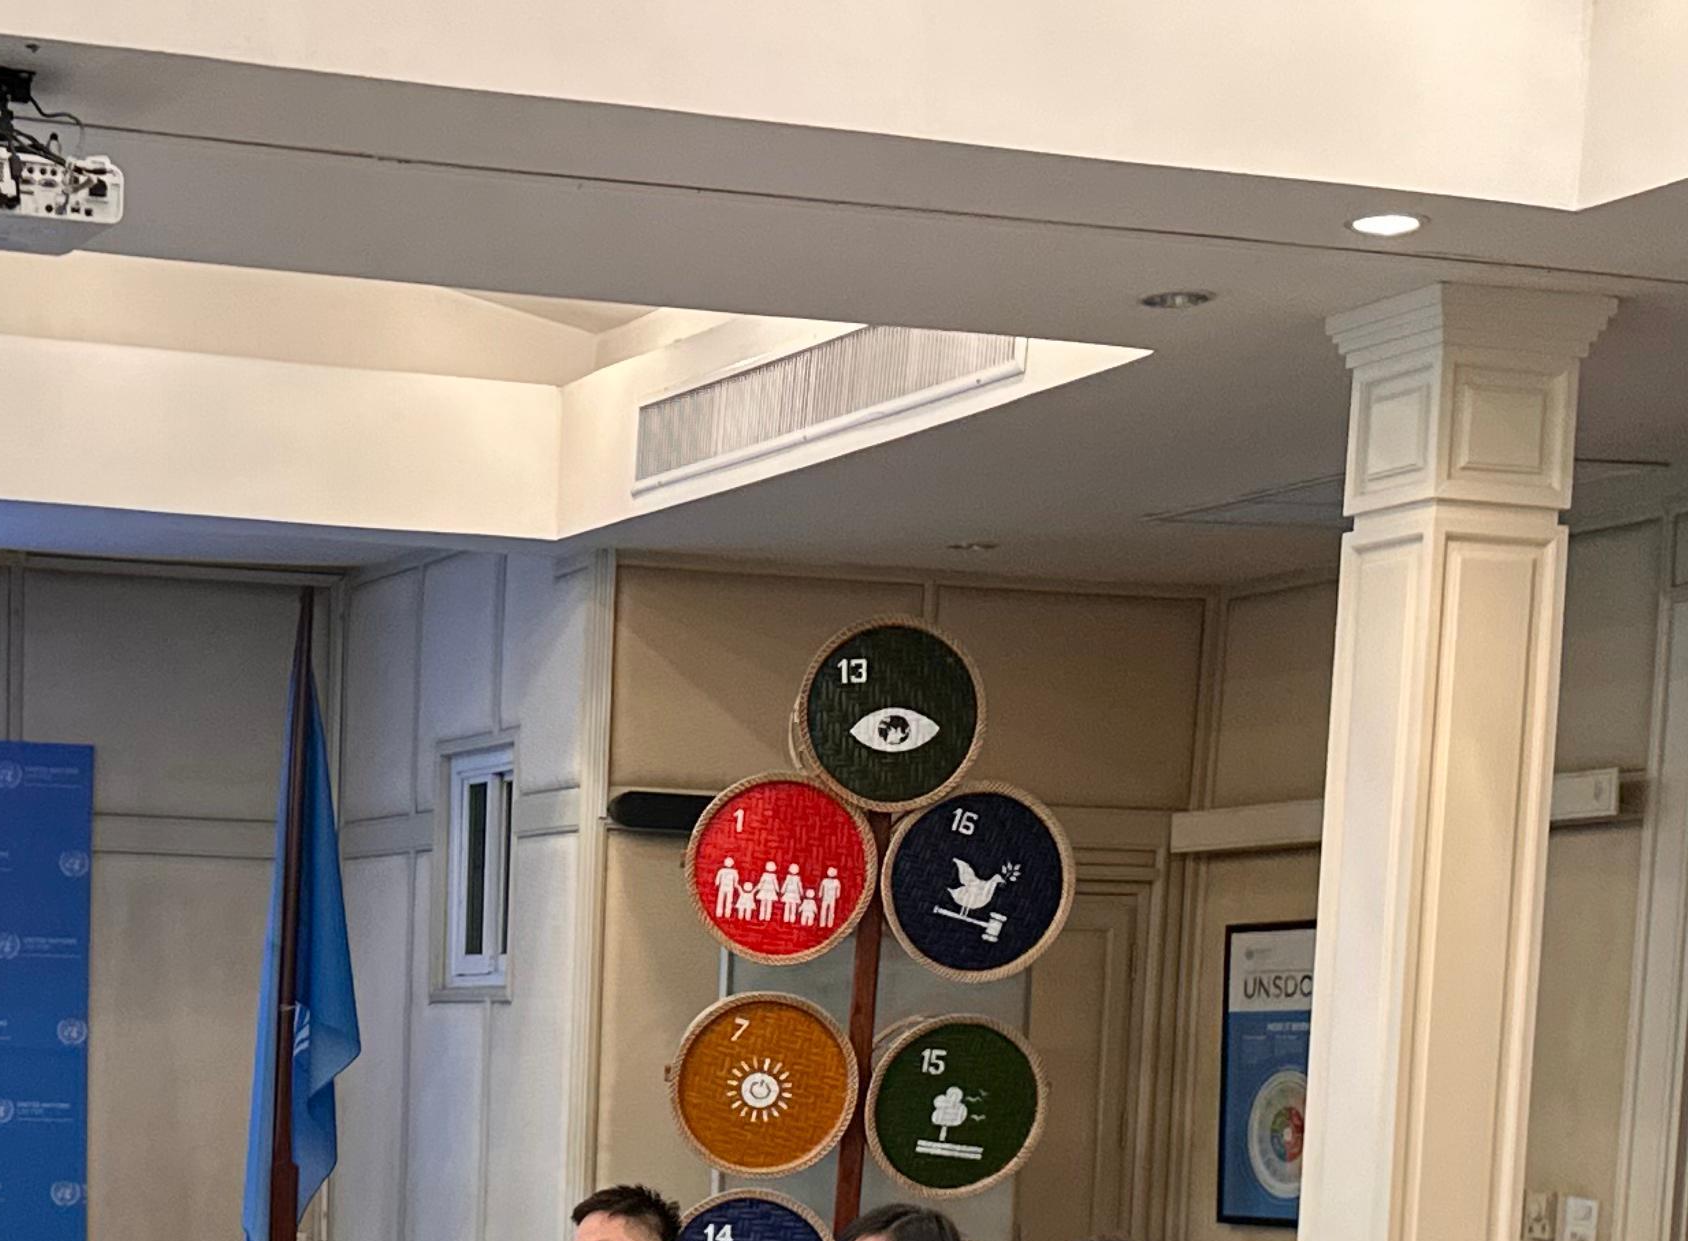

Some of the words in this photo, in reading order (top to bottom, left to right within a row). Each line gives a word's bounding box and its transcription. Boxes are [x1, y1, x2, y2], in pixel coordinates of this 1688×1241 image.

[837, 658, 868, 684] 13
[732, 809, 745, 833] 1
[951, 808, 978, 836] 16
[730, 1017, 751, 1043] 7
[920, 1048, 948, 1075] 15
